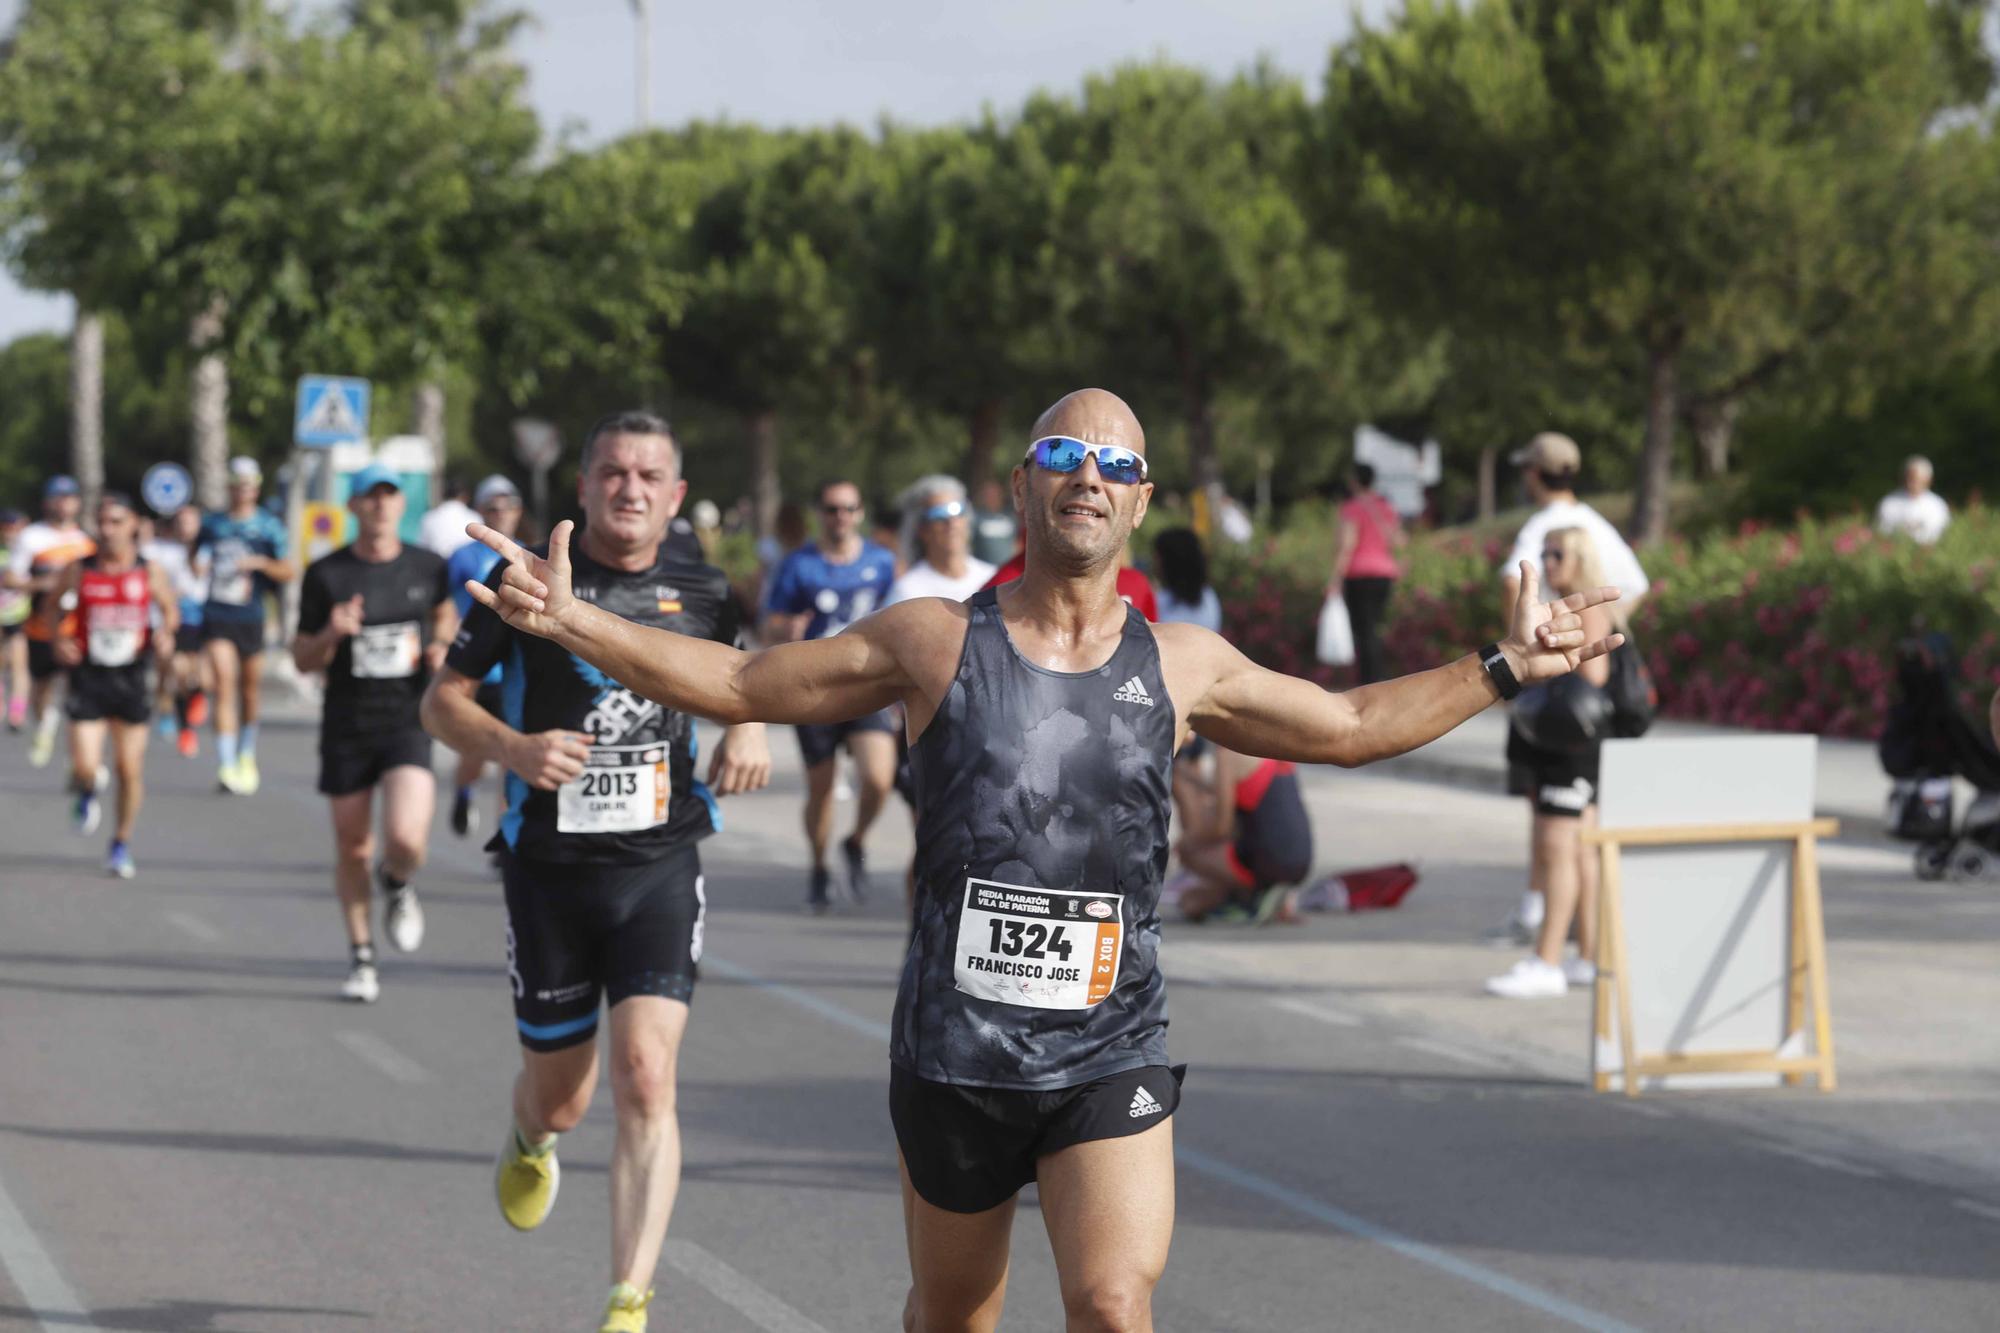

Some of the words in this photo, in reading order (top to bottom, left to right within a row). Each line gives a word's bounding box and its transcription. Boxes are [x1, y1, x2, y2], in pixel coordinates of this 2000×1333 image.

[1113, 692, 1154, 707] adidas
[582, 772, 637, 797] 2013
[978, 889, 1003, 900] MEDIA
[1006, 893, 1050, 906] MARATÓN
[978, 897, 997, 908] VILA
[999, 901, 1010, 910] DE
[1011, 903, 1051, 915] PATERNA
[989, 918, 1072, 962] 1324
[1100, 937, 1115, 962] BOX
[967, 955, 1043, 979] FRANCISCO
[1047, 967, 1080, 982] JOSE
[1097, 965, 1111, 974] 2
[1129, 1103, 1162, 1118] adidas
